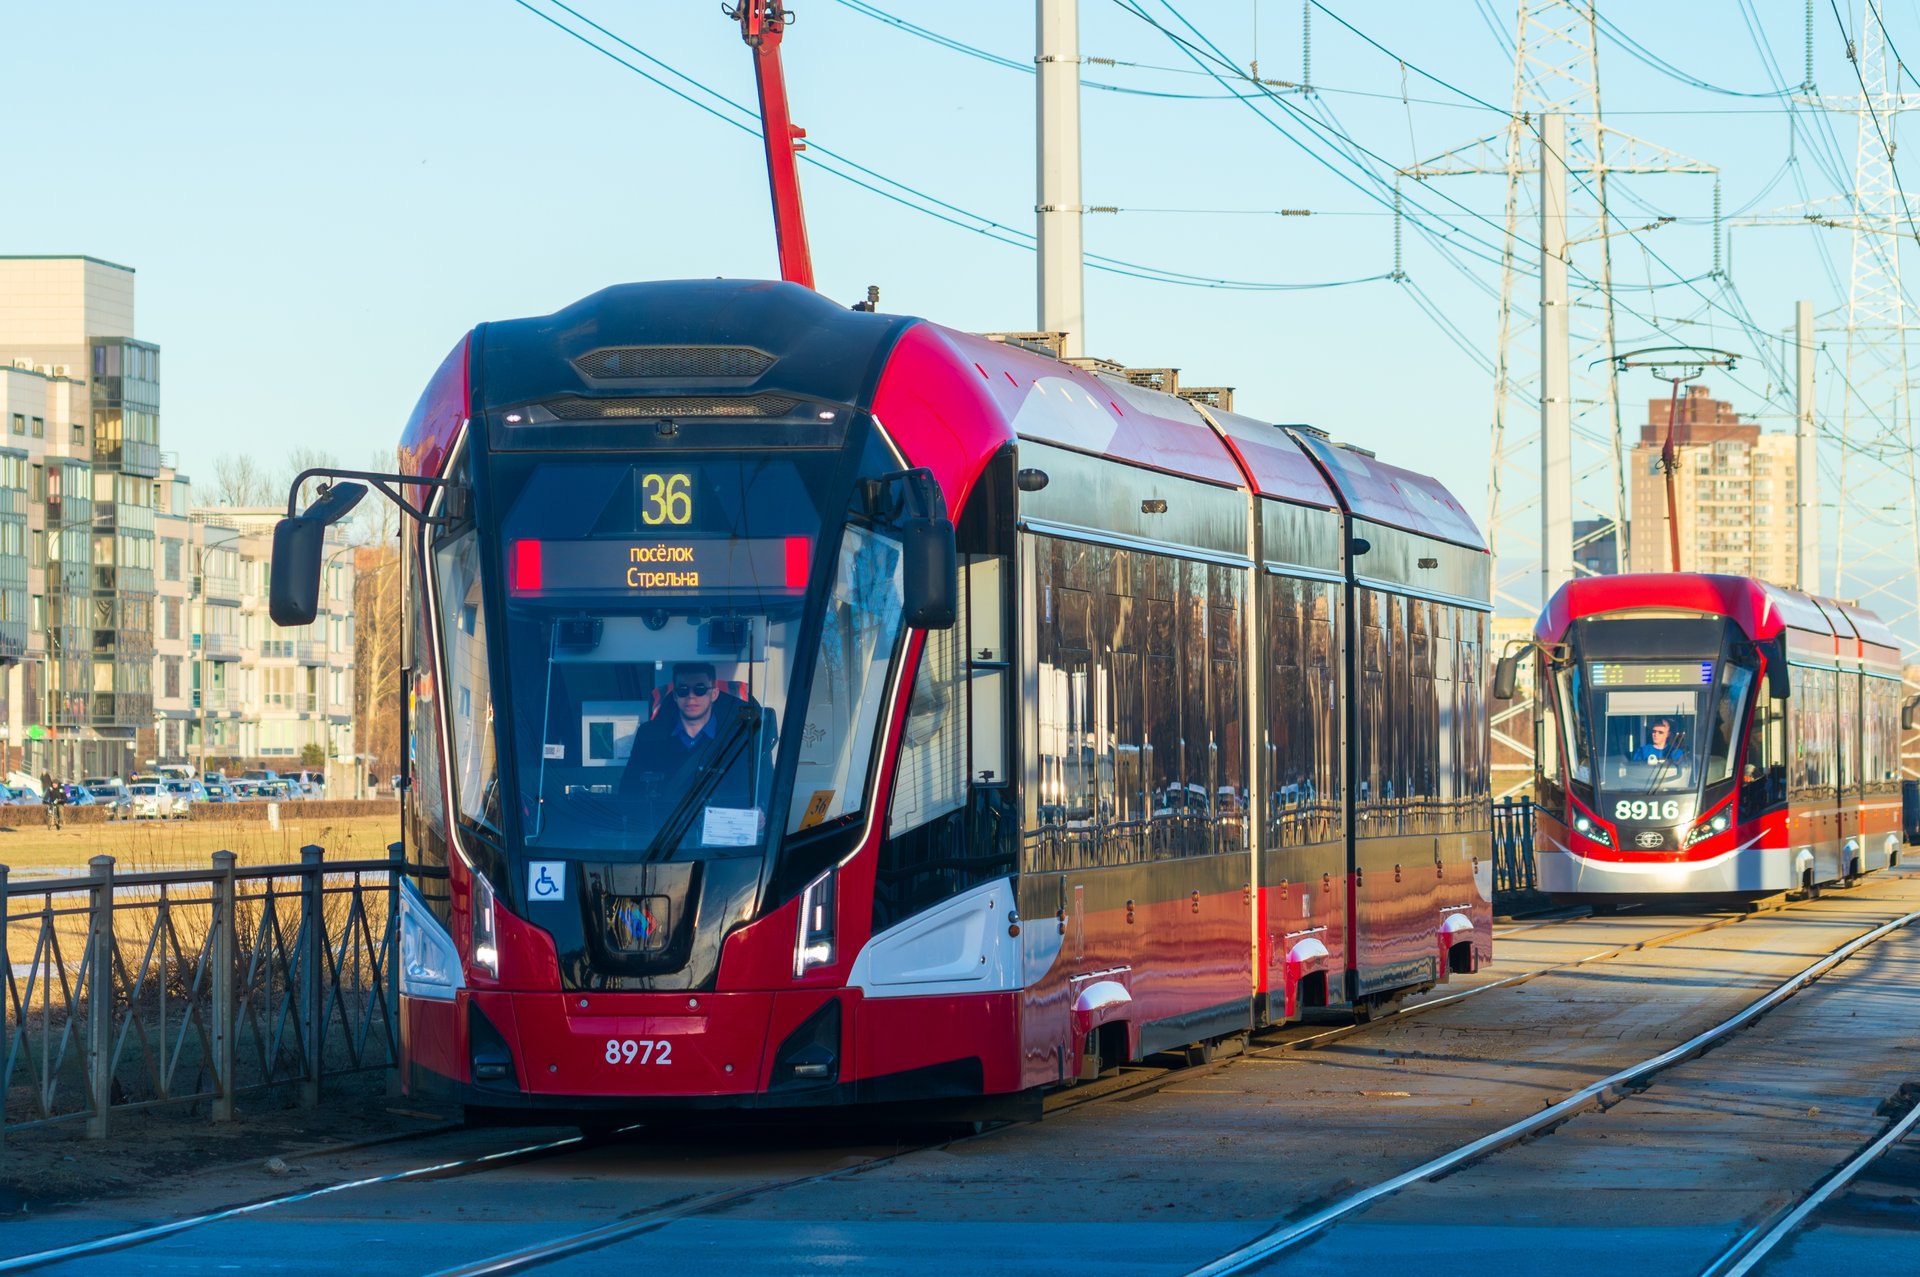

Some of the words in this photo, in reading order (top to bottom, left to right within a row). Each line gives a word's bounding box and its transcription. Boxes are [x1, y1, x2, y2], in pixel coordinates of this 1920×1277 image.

[642, 473, 692, 525] 36
[630, 544, 694, 562] посёлок
[627, 567, 699, 588] Стрельна
[1615, 800, 1679, 820] 8916
[605, 1039, 672, 1065] 8972
